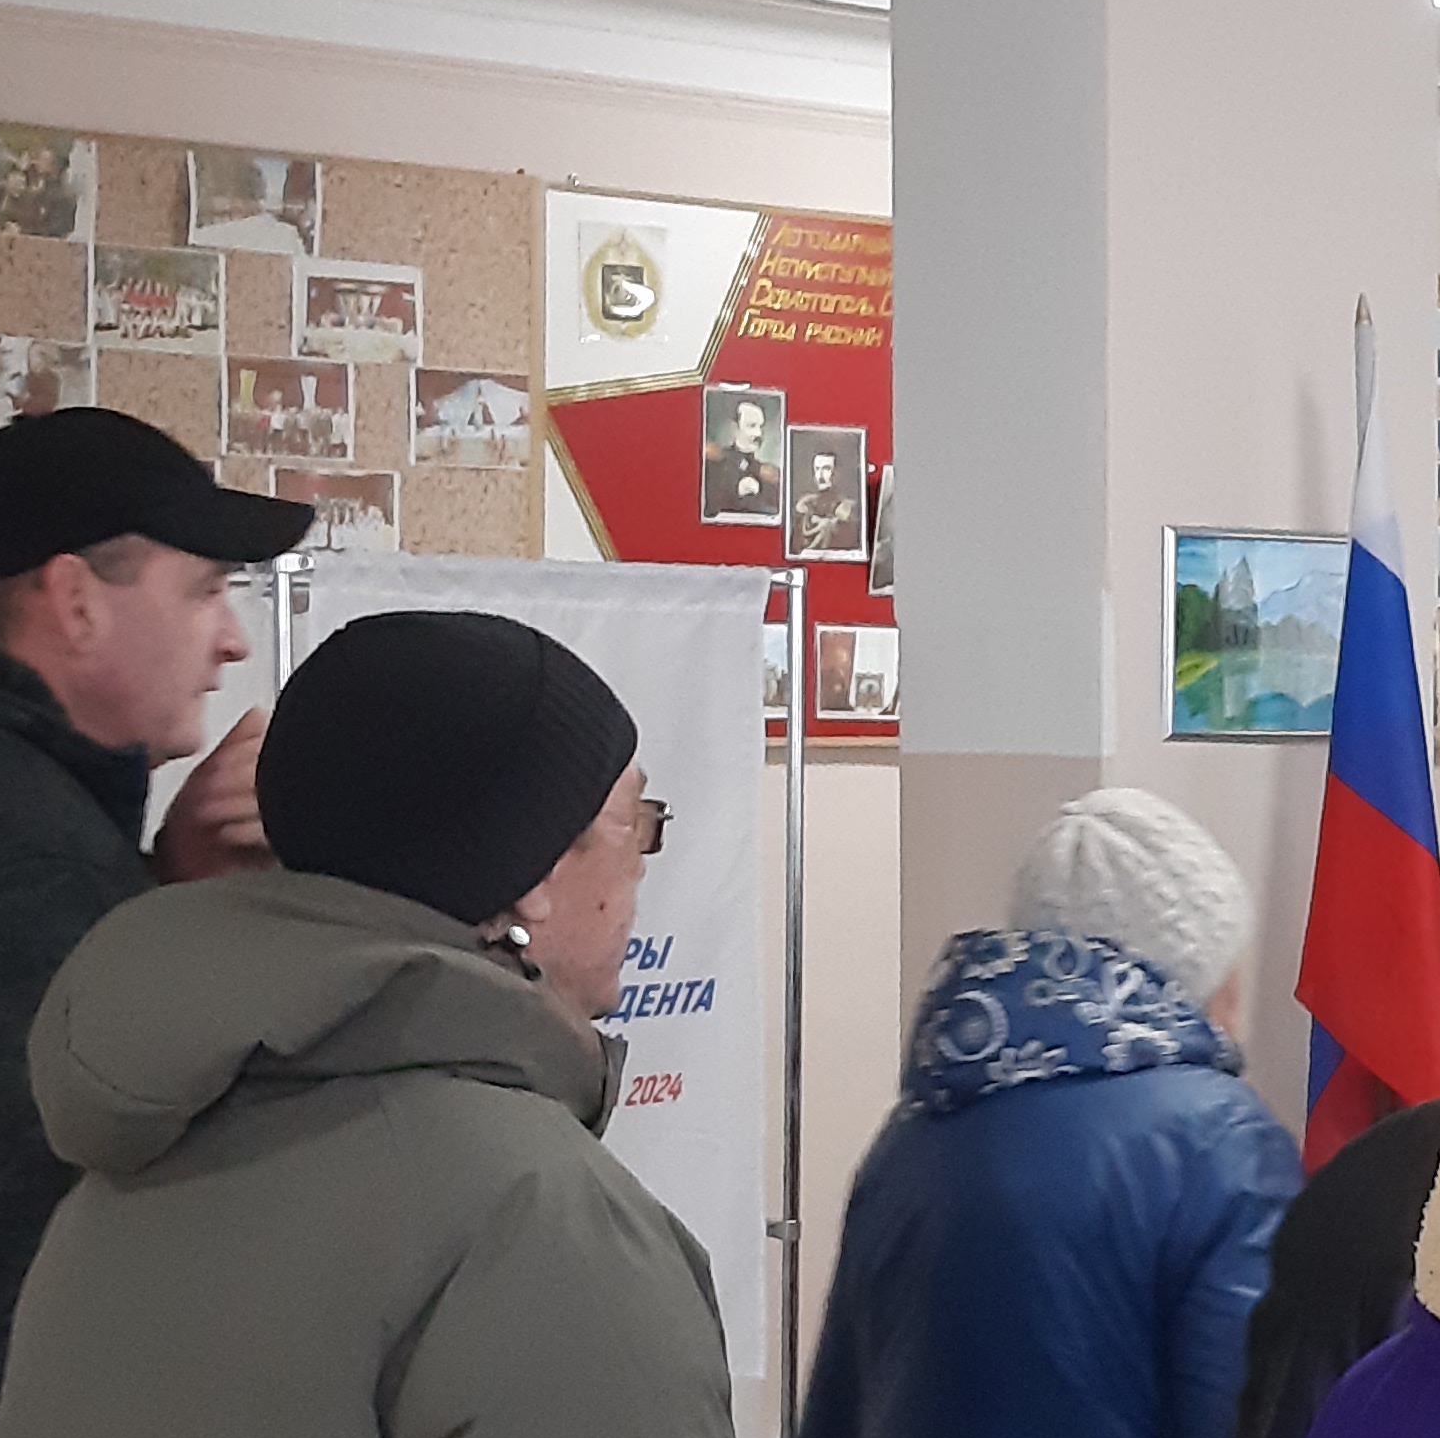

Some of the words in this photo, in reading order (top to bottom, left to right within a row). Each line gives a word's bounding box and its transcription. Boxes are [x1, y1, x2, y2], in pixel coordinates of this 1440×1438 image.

[623, 935, 674, 971] РЫ
[604, 977, 716, 1025] ДЕНТА
[624, 1072, 683, 1107] 2024
